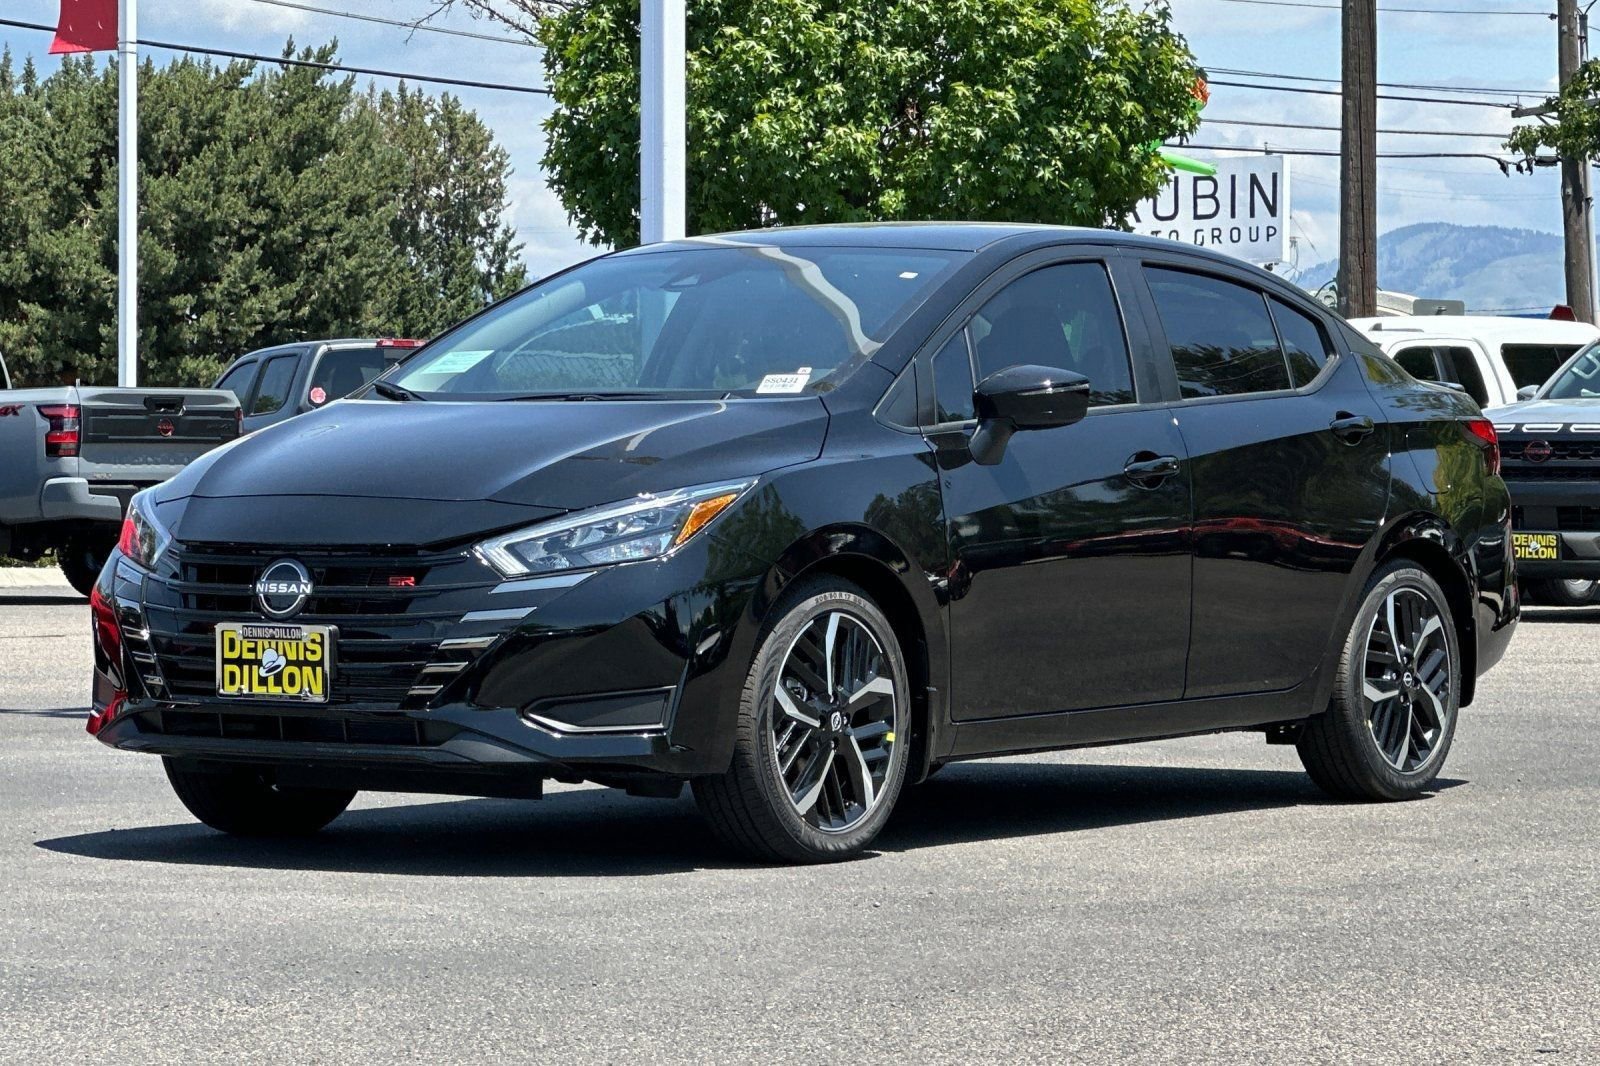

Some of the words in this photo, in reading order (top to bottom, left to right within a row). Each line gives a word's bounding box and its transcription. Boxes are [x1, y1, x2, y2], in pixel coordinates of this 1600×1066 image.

[1131, 172, 1278, 223] UBIN
[1194, 226, 1277, 246] GROUP
[256, 583, 311, 594] NISSAN
[389, 576, 415, 587] SR
[243, 626, 269, 638] DENNIS
[274, 627, 302, 639] DILLON
[223, 665, 323, 695] DILLON
